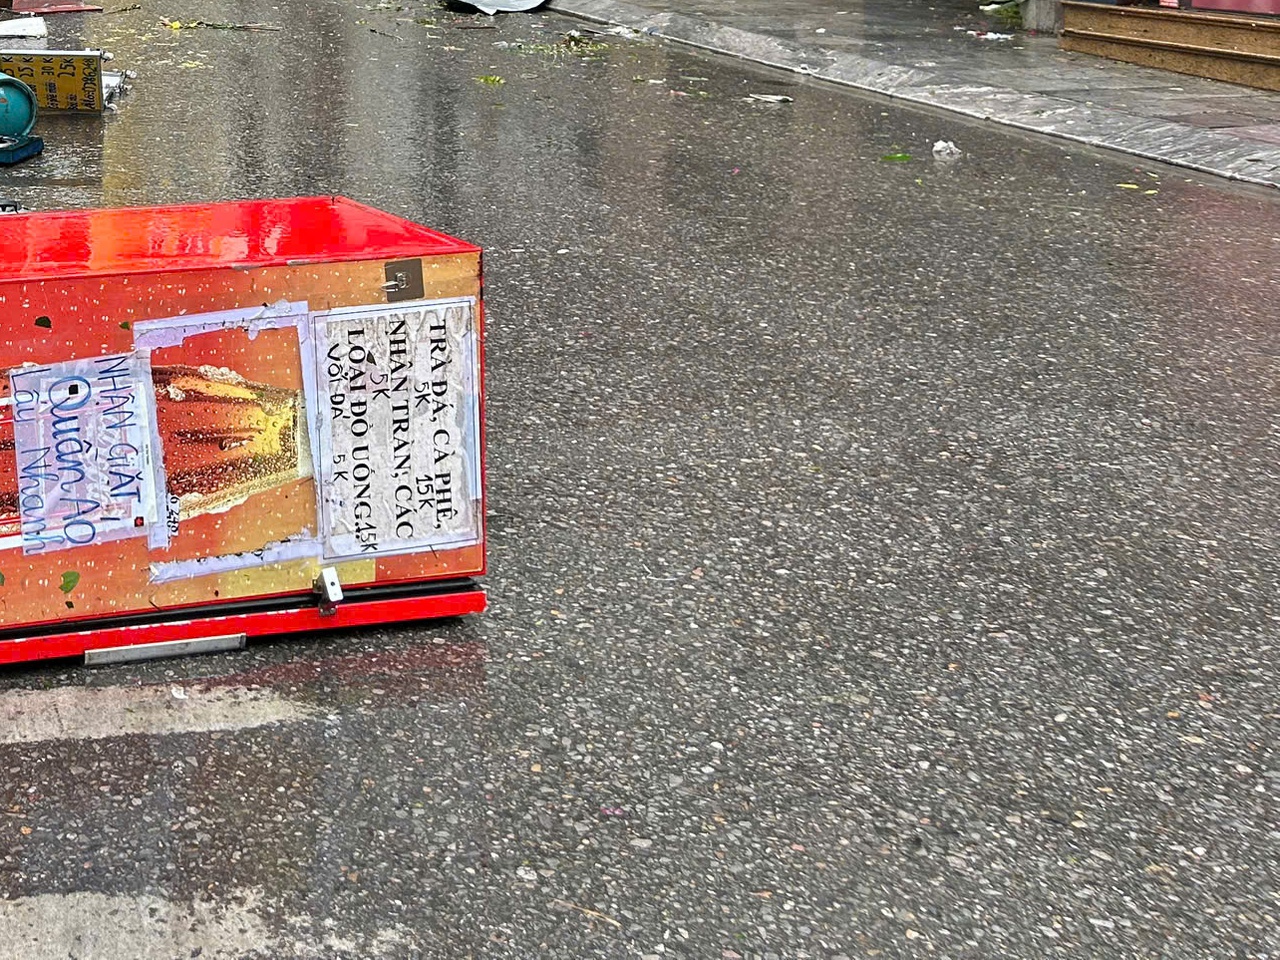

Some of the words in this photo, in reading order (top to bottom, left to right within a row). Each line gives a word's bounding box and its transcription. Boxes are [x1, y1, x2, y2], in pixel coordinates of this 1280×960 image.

[388, 320, 414, 392] NHÂN
[429, 319, 453, 372] TRÀ
[94, 356, 137, 430] NHẬN
[430, 380, 454, 423] ĐÁ,
[433, 428, 455, 464] CÀ
[19, 446, 66, 554] Nhanh
[394, 485, 417, 539] CÁC
[434, 472, 458, 529] PHÊ,
